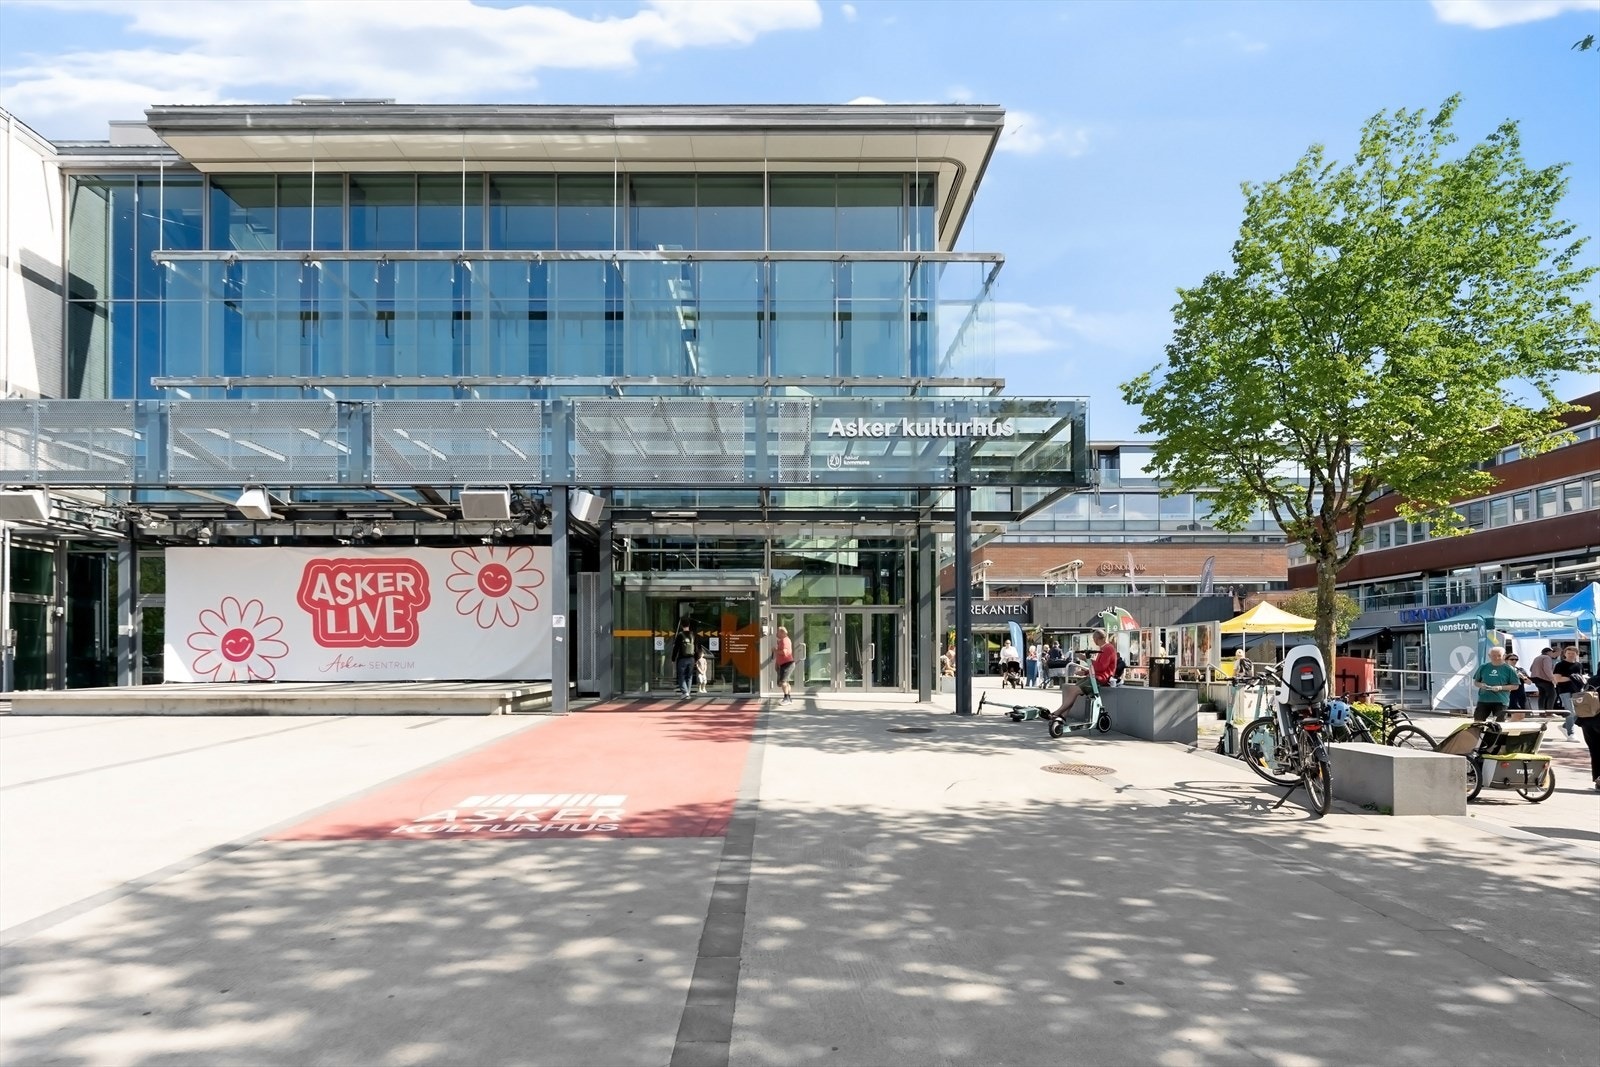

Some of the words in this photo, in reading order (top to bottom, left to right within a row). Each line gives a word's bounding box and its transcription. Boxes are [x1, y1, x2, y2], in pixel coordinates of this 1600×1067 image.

[828, 417, 896, 437] Asker
[902, 417, 1014, 437] kulturhus
[311, 572, 416, 606] ASKER
[326, 594, 406, 634] LIVE
[1438, 622, 1478, 632] venstre.n
[1508, 620, 1564, 628] venstre.no
[319, 653, 365, 673] Asker
[369, 661, 415, 670] SENTRUM
[413, 808, 627, 822] ASKER
[391, 823, 620, 834] KULTURHUS
